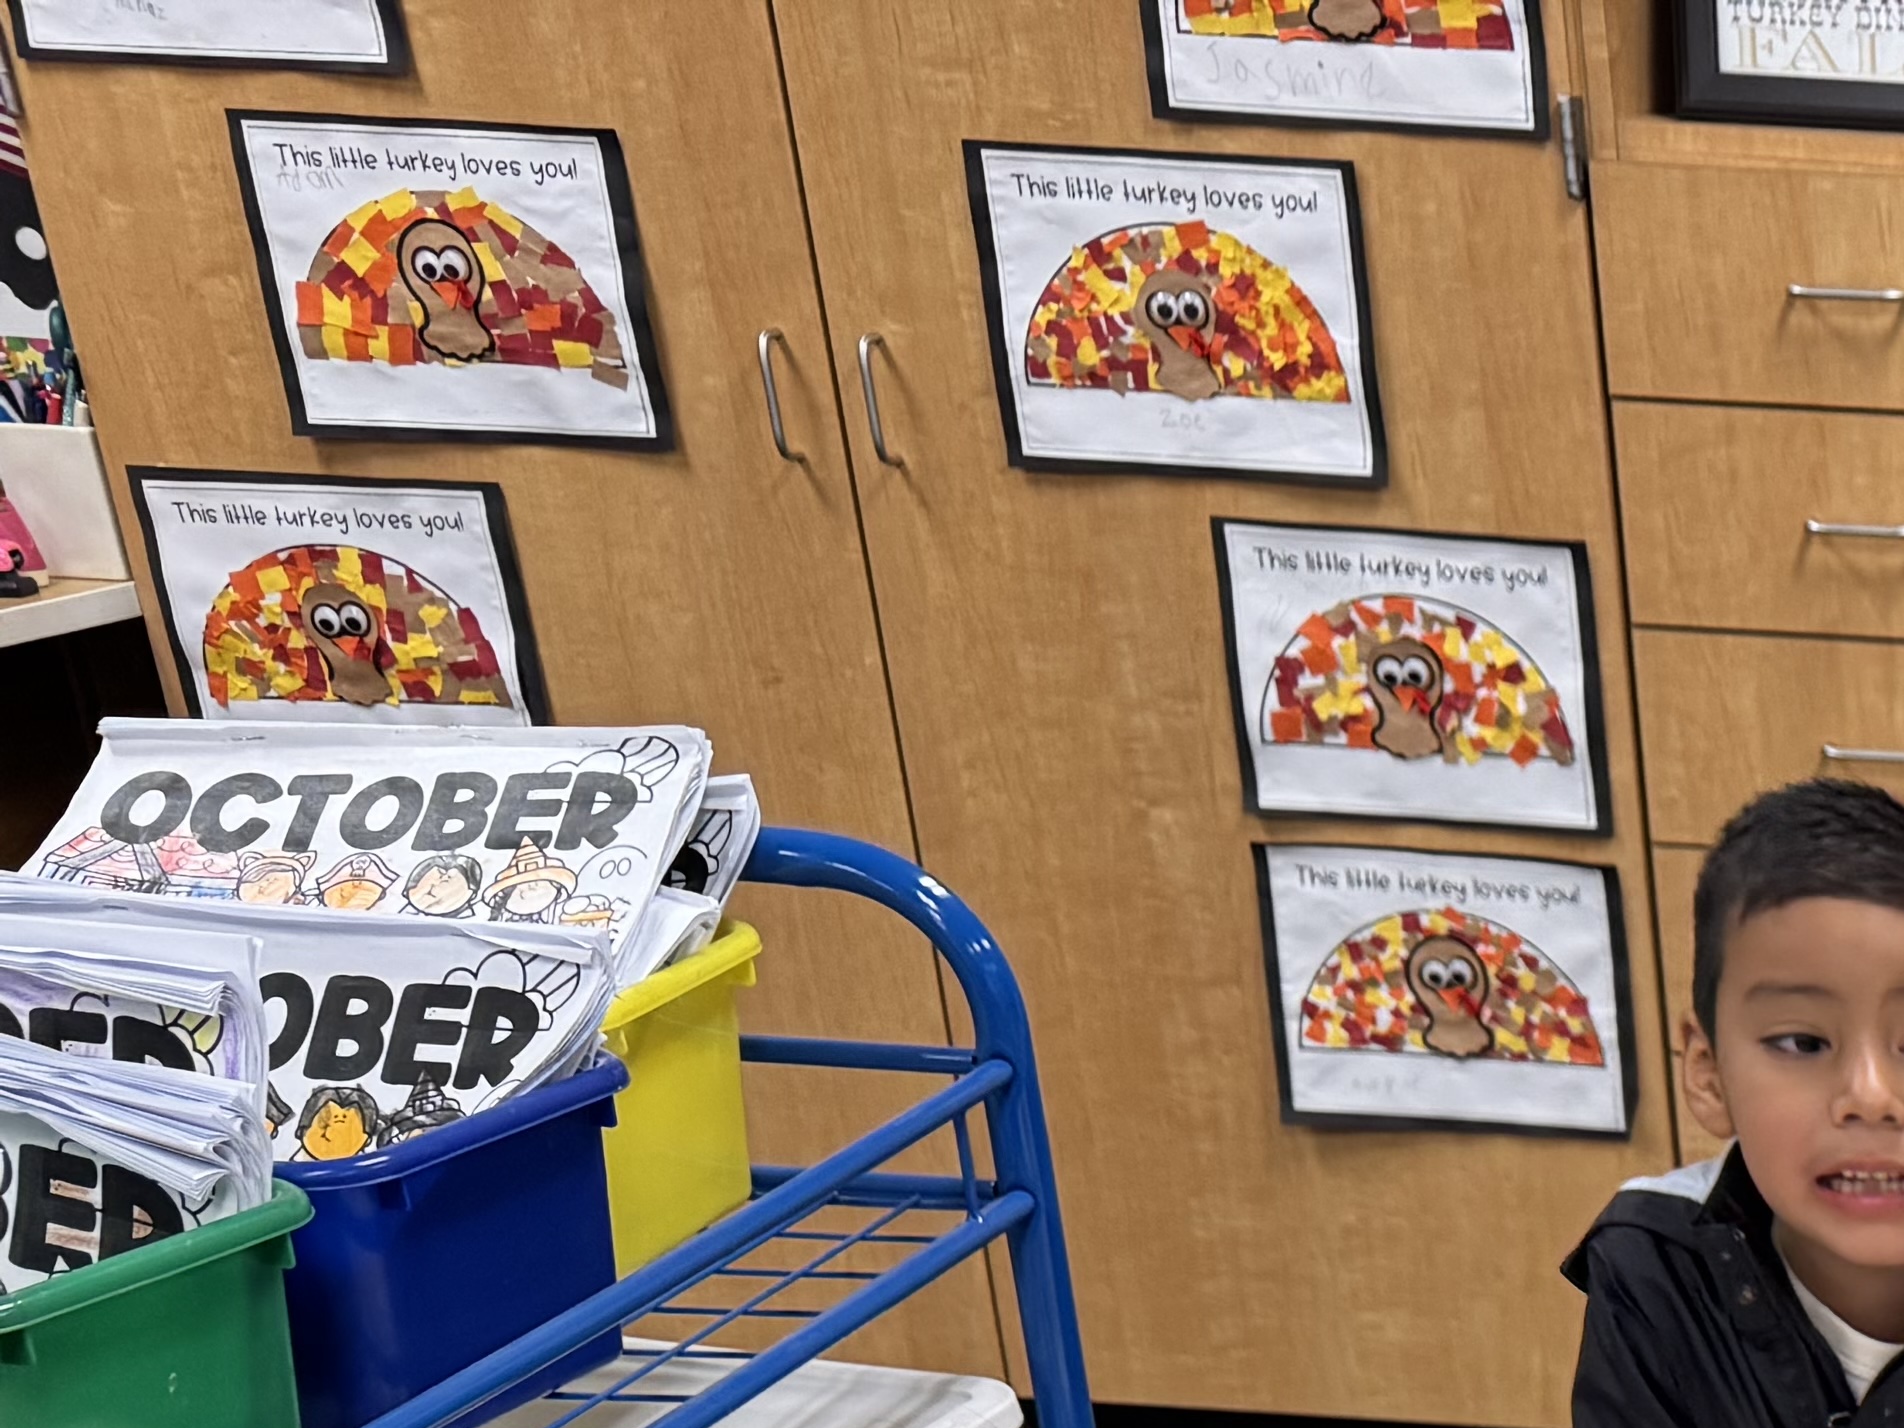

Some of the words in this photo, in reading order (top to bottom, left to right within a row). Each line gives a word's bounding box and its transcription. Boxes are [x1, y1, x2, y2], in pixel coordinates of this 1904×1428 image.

[273, 143, 322, 168] This
[328, 146, 377, 171] little
[386, 148, 456, 181] turkey
[463, 152, 521, 178] loves
[531, 158, 578, 185] you!
[1011, 173, 1058, 197] This
[1066, 176, 1113, 201] little
[1123, 179, 1196, 214] turkey
[1204, 184, 1263, 210] loves
[1272, 191, 1318, 219] you!
[171, 502, 217, 523] This
[224, 504, 267, 526] little
[276, 506, 349, 535] turkey
[354, 508, 412, 530] loves
[420, 512, 464, 537] you!
[1253, 546, 1298, 571] This
[1305, 550, 1351, 575] little
[1359, 552, 1431, 586] turkey
[1436, 559, 1495, 581] loves
[101, 771, 638, 854] OCTOBER
[1295, 863, 1338, 887] This
[1345, 867, 1390, 892] little
[1399, 870, 1467, 904] turkey
[1473, 875, 1530, 900] loves
[262, 972, 540, 1090] OBER
